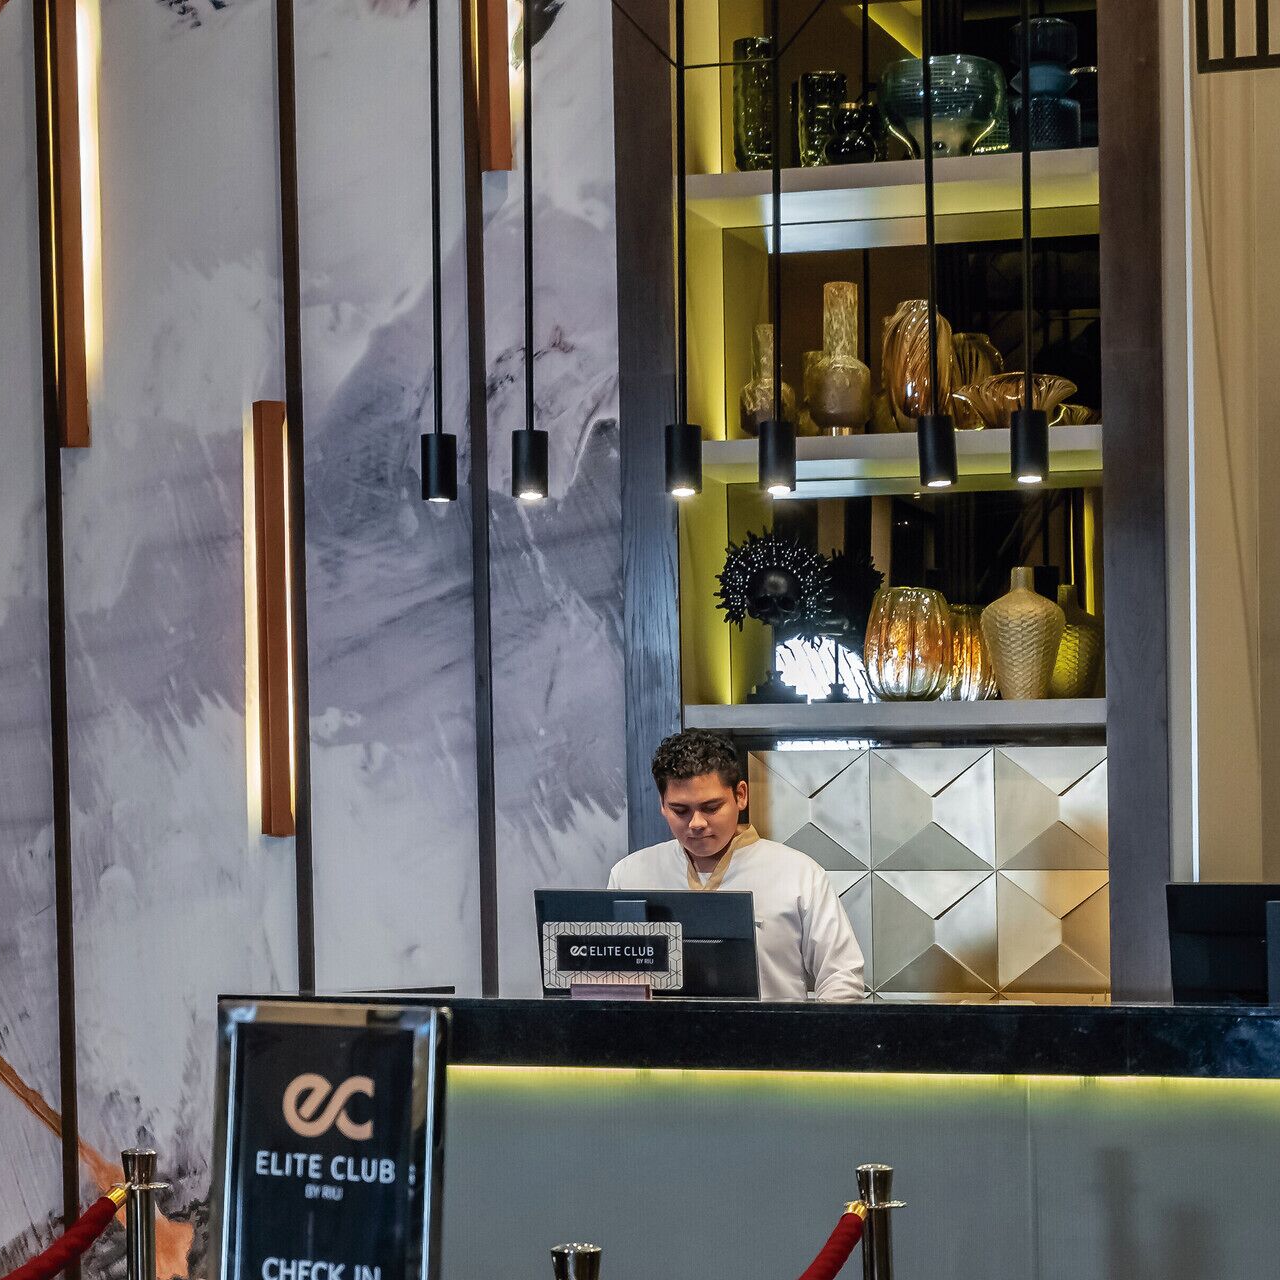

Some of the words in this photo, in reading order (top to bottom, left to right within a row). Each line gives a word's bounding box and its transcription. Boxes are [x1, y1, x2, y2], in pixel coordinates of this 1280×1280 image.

[589, 945, 621, 957] ELITE
[623, 945, 654, 957] CLUB
[255, 1150, 323, 1180] ELITE
[330, 1155, 396, 1184] CLUB
[304, 1183, 320, 1199] BY
[321, 1184, 344, 1201] RIU
